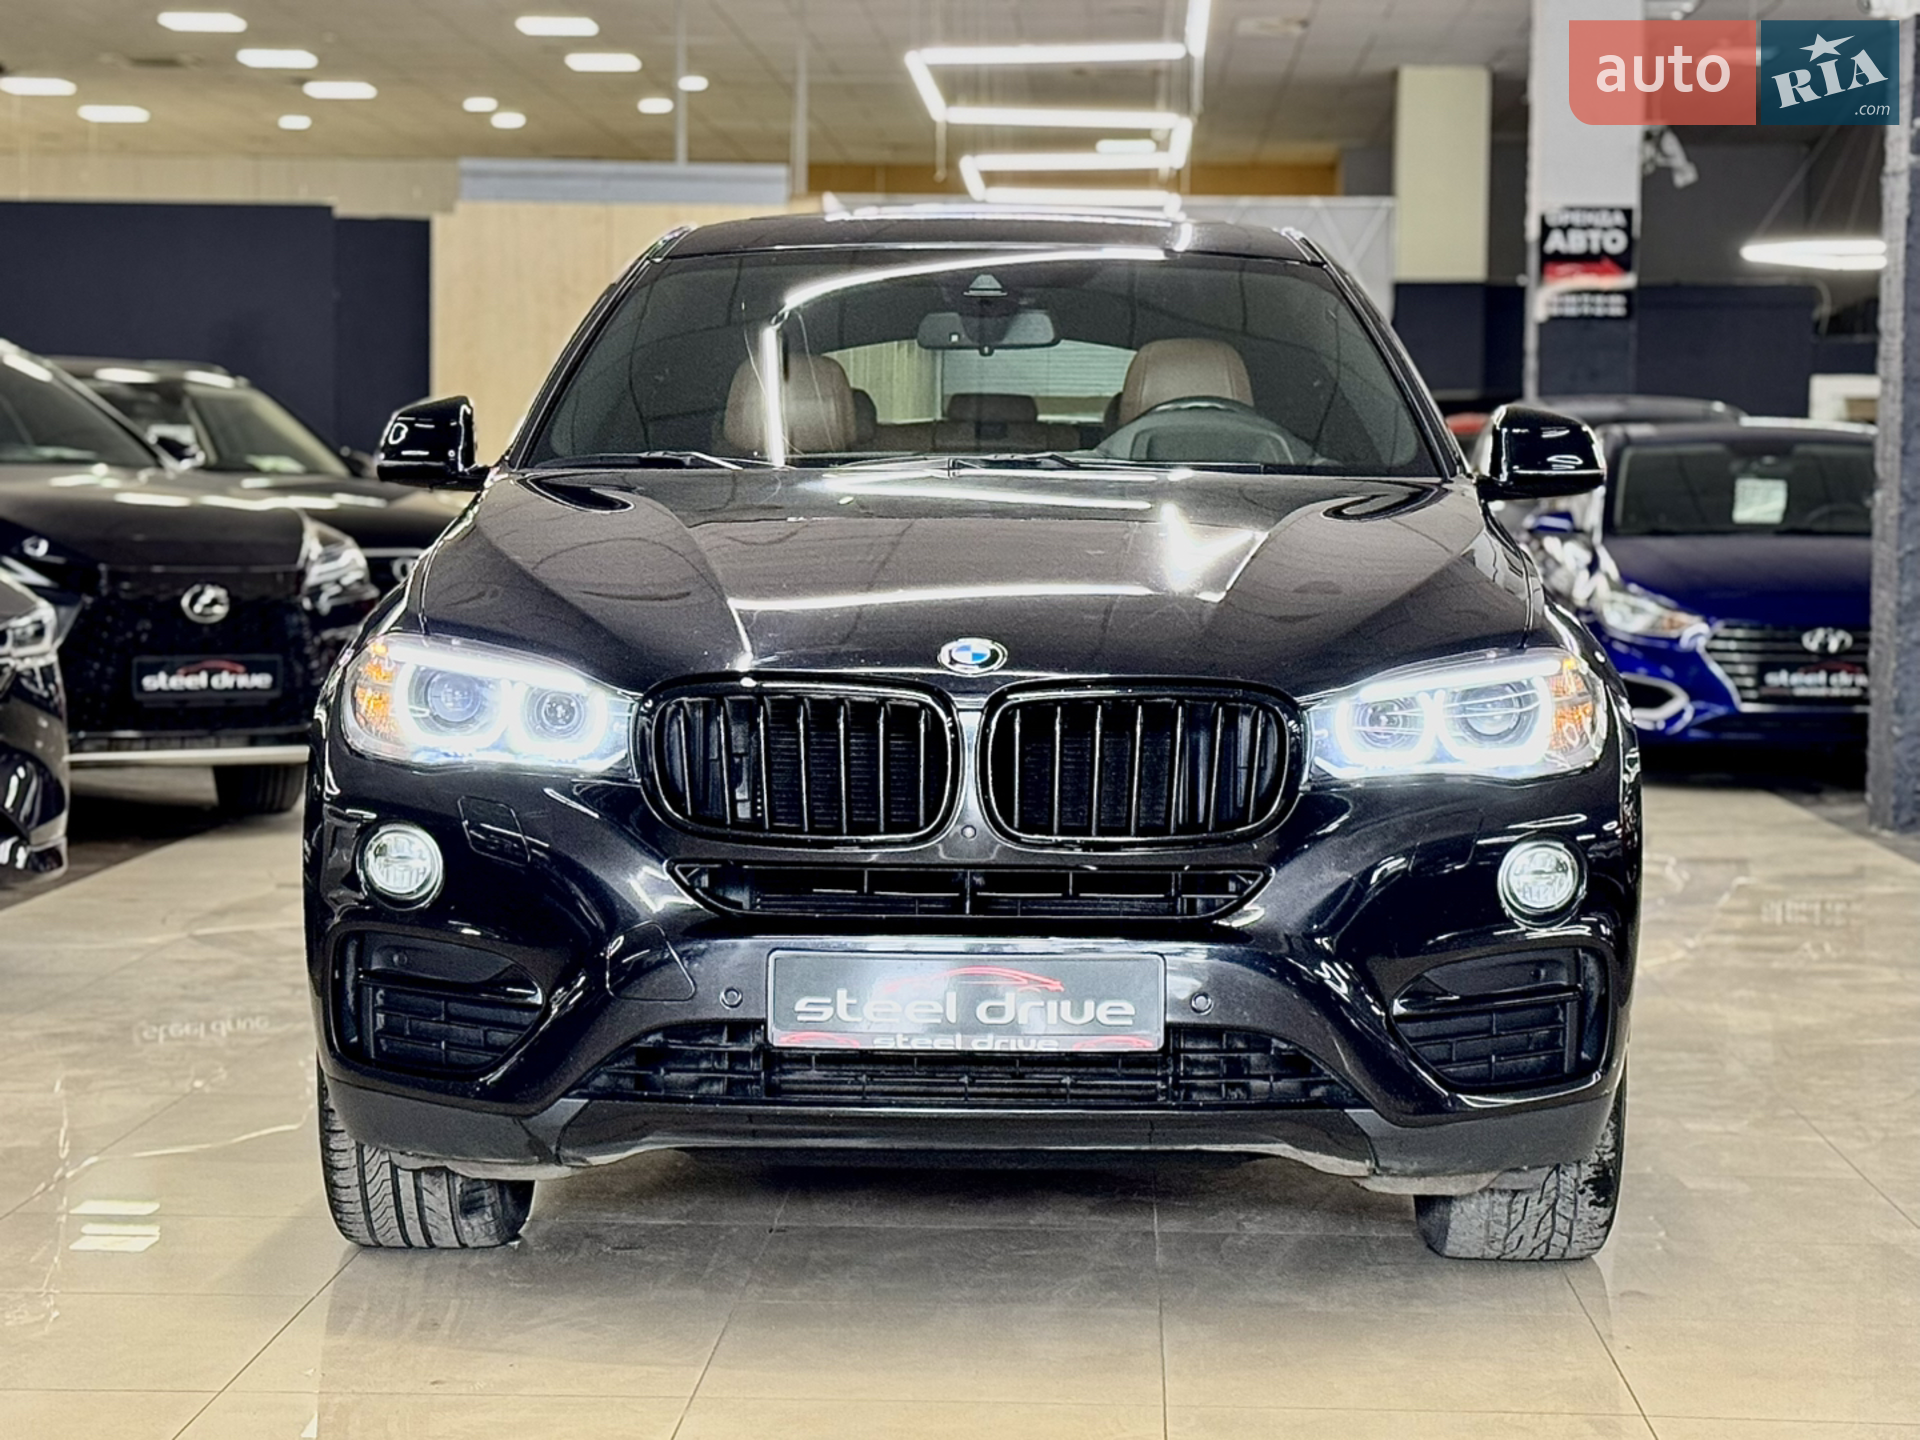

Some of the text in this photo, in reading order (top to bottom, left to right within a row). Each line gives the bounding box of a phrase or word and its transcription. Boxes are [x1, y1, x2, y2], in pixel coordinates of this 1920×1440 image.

[1543, 228, 1629, 255] АВТО
[141, 670, 273, 692] steel drive
[793, 987, 1136, 1026] steel drive
[873, 1033, 1060, 1051] steel drive
